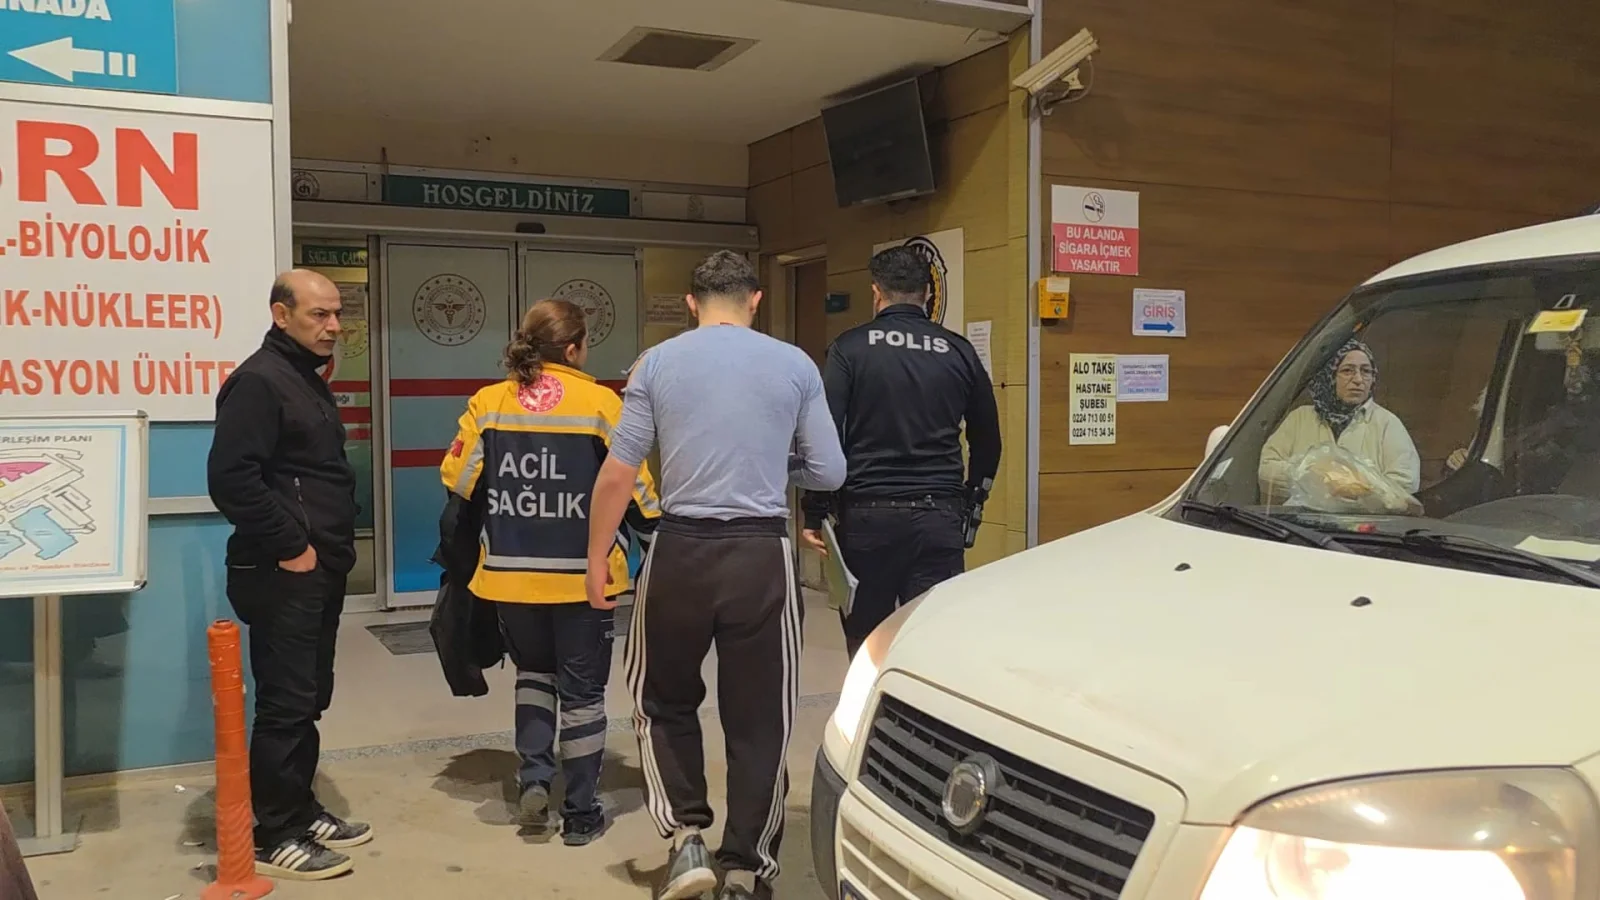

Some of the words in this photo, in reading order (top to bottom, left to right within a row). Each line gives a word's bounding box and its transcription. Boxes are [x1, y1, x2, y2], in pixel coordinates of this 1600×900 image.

[0, 119, 199, 210] RN
[0, 212, 210, 263] -BİYOLOJİK
[1066, 226, 1081, 239] BU
[1083, 227, 1125, 241] ALANDA
[1058, 240, 1098, 255] SİGARA
[1100, 242, 1132, 258] İÇMEK
[1070, 258, 1120, 272] YASAKTIR
[0, 284, 222, 339] K-NÜKLEER)
[1073, 361, 1090, 375] ALO
[0, 359, 120, 396] ASYON
[1075, 383, 1112, 394] HASTANE
[1072, 413, 1087, 423] 0224
[1087, 413, 1098, 422] 713
[1107, 413, 1114, 423] 51
[0, 435, 50, 444] RLEŞİM
[54, 434, 92, 443] PLANI
[1072, 427, 1087, 437] 0224
[1099, 427, 1106, 437] 34
[1107, 427, 1114, 437] 34
[497, 447, 567, 480] ACİL
[487, 484, 586, 519] SAĞLIK
